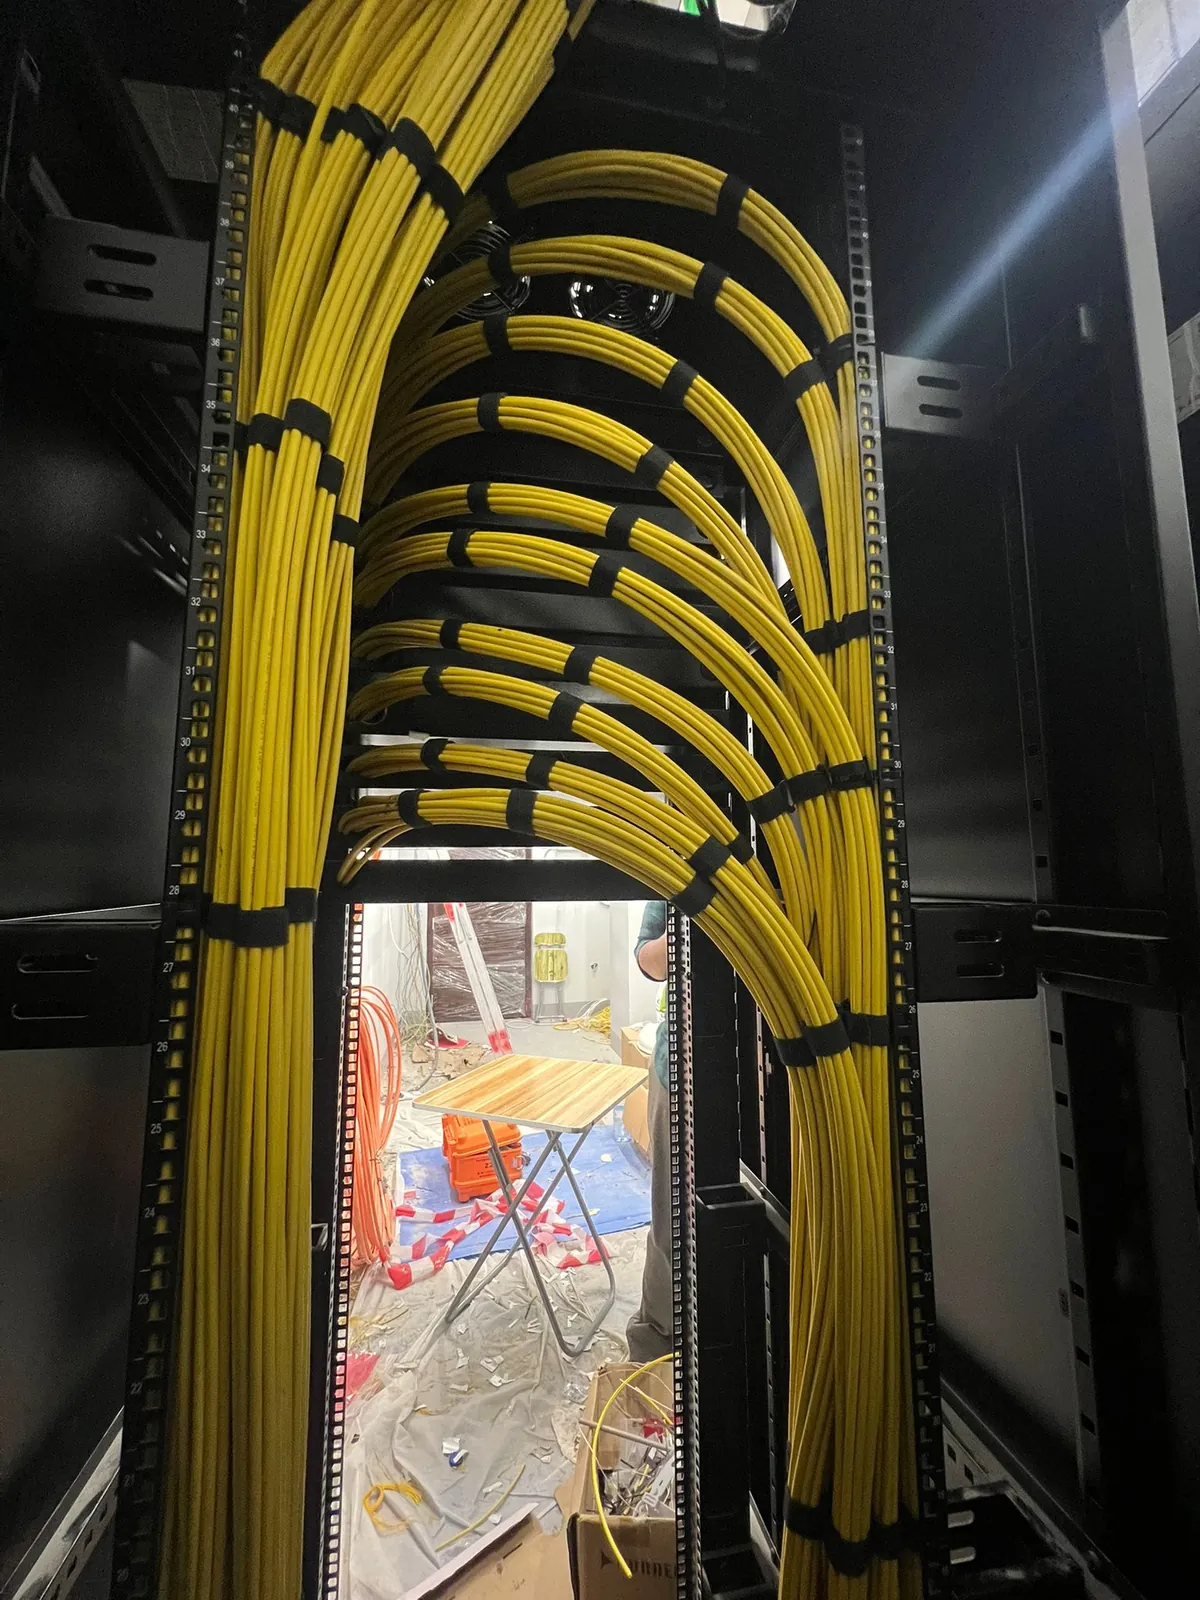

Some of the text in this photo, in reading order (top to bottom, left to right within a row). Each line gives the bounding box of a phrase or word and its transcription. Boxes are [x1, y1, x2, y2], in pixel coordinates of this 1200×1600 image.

[229, 104, 239, 113] 40
[225, 160, 234, 169] 39
[220, 217, 230, 227] 38
[215, 277, 225, 286] 37
[211, 338, 220, 347] 36
[206, 400, 216, 409] 35
[201, 464, 211, 473] 34
[196, 530, 206, 539] 33
[881, 536, 888, 544] 34
[884, 590, 892, 599] 33
[191, 597, 201, 606] 32
[887, 646, 895, 654] 32
[185, 666, 195, 675] 31
[890, 702, 898, 711] 31
[180, 737, 191, 747] 30
[894, 760, 902, 769] 30
[175, 810, 186, 820] 29
[897, 819, 905, 828] 29
[901, 880, 909, 889] 28
[169, 885, 180, 895] 28
[905, 942, 912, 951] 27
[163, 962, 174, 973] 27
[908, 1005, 916, 1014] 26
[157, 1042, 168, 1052] 26
[912, 1069, 920, 1079] 25
[151, 1123, 162, 1134] 25
[916, 1135, 923, 1145] 24
[920, 1202, 928, 1212] 23
[144, 1207, 155, 1219] 24
[924, 1272, 932, 1282] 22
[138, 1293, 149, 1305] 23
